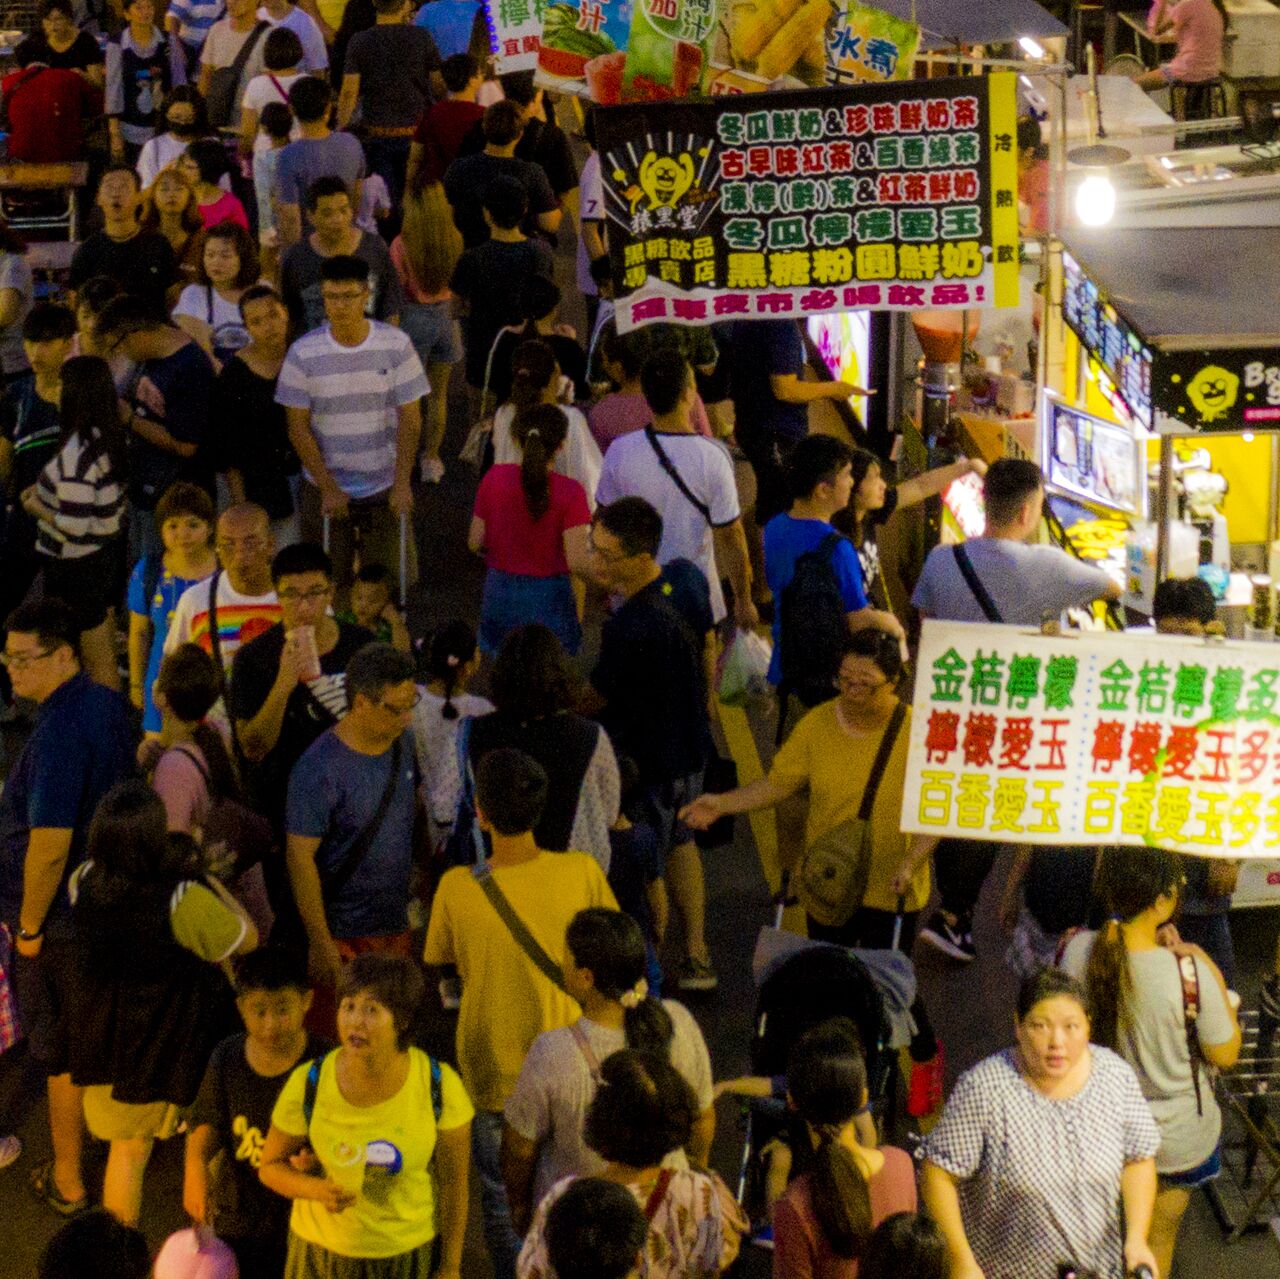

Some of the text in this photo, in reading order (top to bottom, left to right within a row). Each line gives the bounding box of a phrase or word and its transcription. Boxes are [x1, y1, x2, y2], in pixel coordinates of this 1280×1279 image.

[830, 26, 899, 78] 水煮
[624, 236, 715, 266] 黑糖飲品
[724, 207, 982, 251] 冬瓜檸檬愛玉
[727, 241, 984, 288] 黑糖粉圓鮮奶
[931, 646, 1078, 711] 金桔檸檬
[925, 708, 1069, 772] 檸檬愛玉
[919, 770, 1064, 834] 百香愛玉
